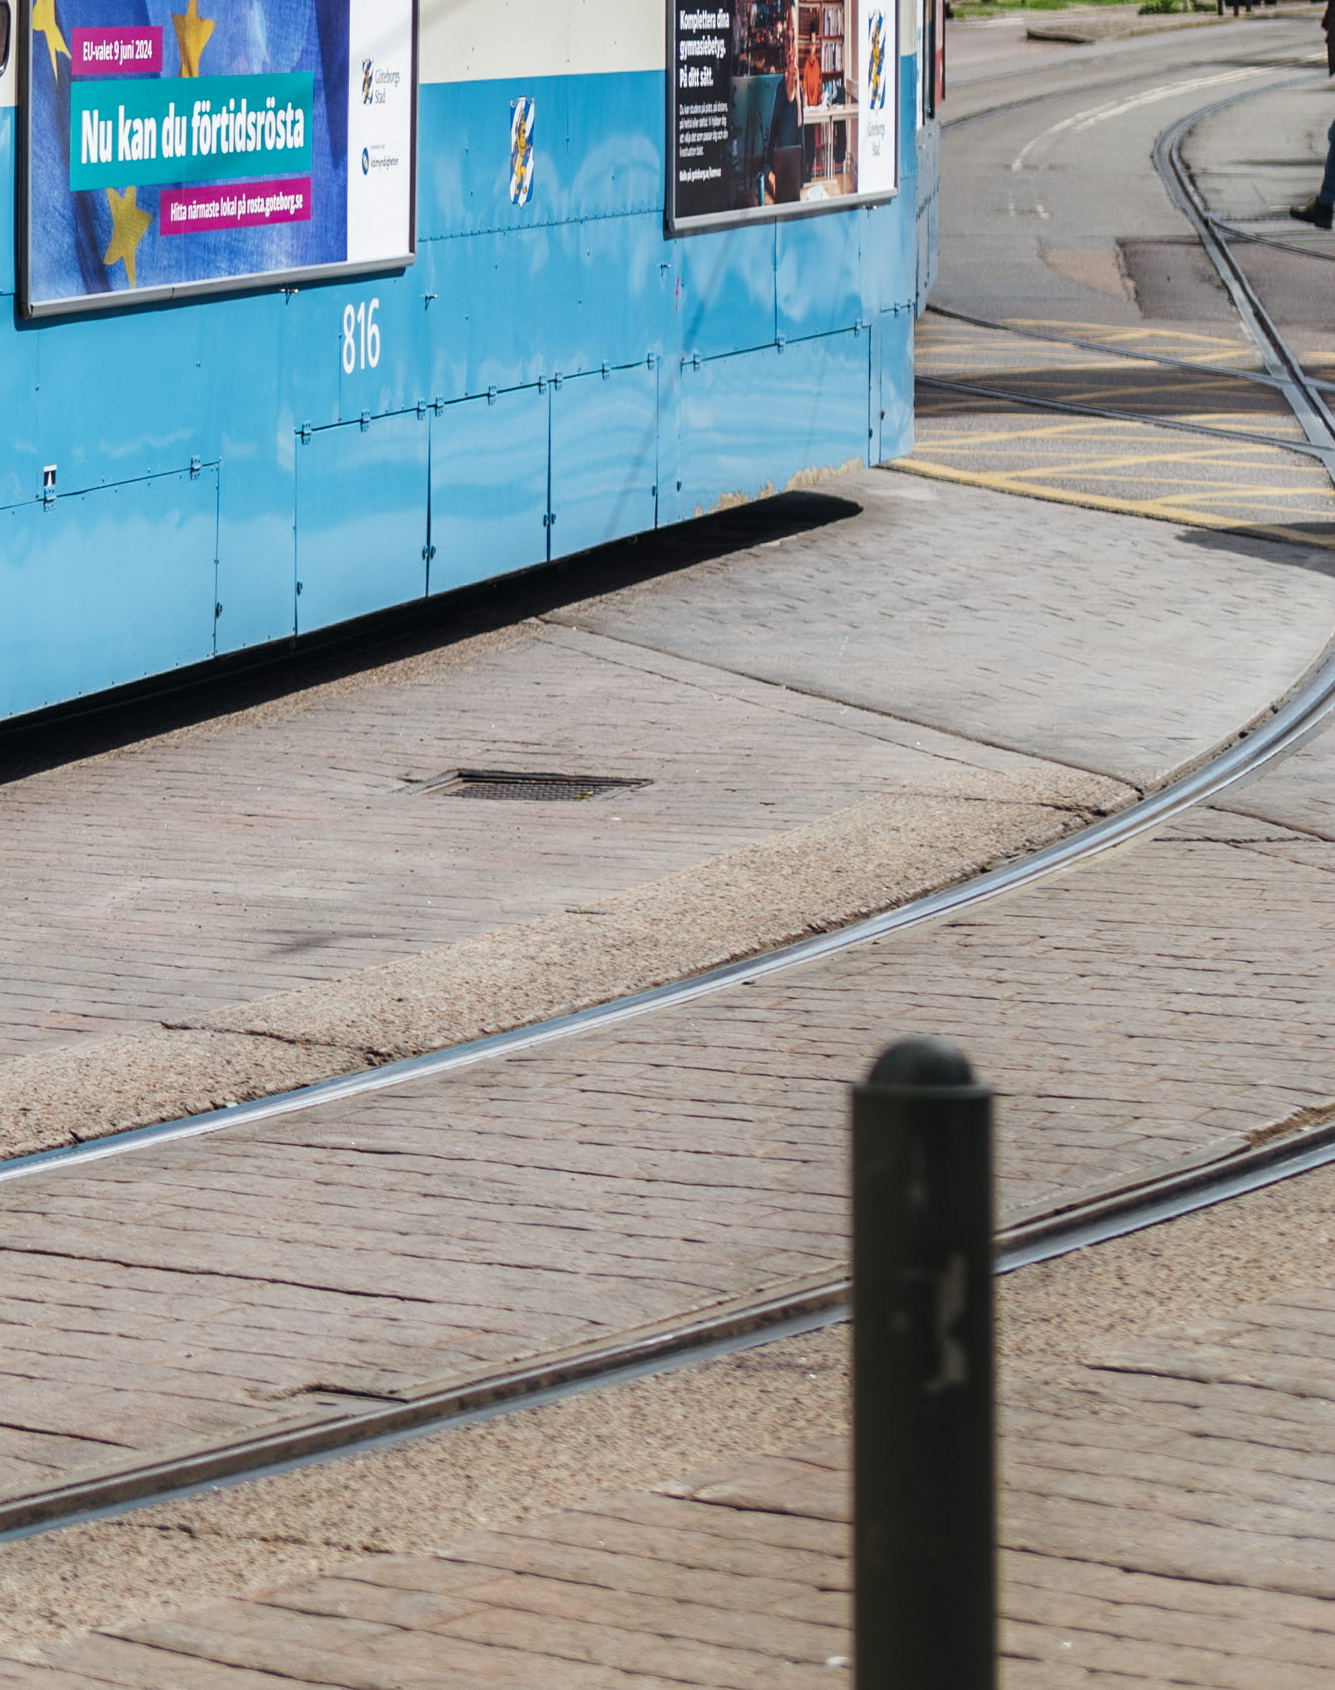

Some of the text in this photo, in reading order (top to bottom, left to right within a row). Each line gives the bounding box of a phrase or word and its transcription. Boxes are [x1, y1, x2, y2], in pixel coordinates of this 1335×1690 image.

[679, 8, 730, 34] Komplettera dina
[83, 39, 153, 65] EU-valet 9 juni 2024
[374, 68, 400, 87] Göteborgs
[679, 64, 714, 88] På ditt sätt.
[374, 88, 386, 104] Stad
[81, 96, 305, 164] Nu kan du förtidsrösta
[170, 191, 304, 222] Hitta närmaste lokal på rosta.goteborg.se
[342, 297, 381, 375] 816
